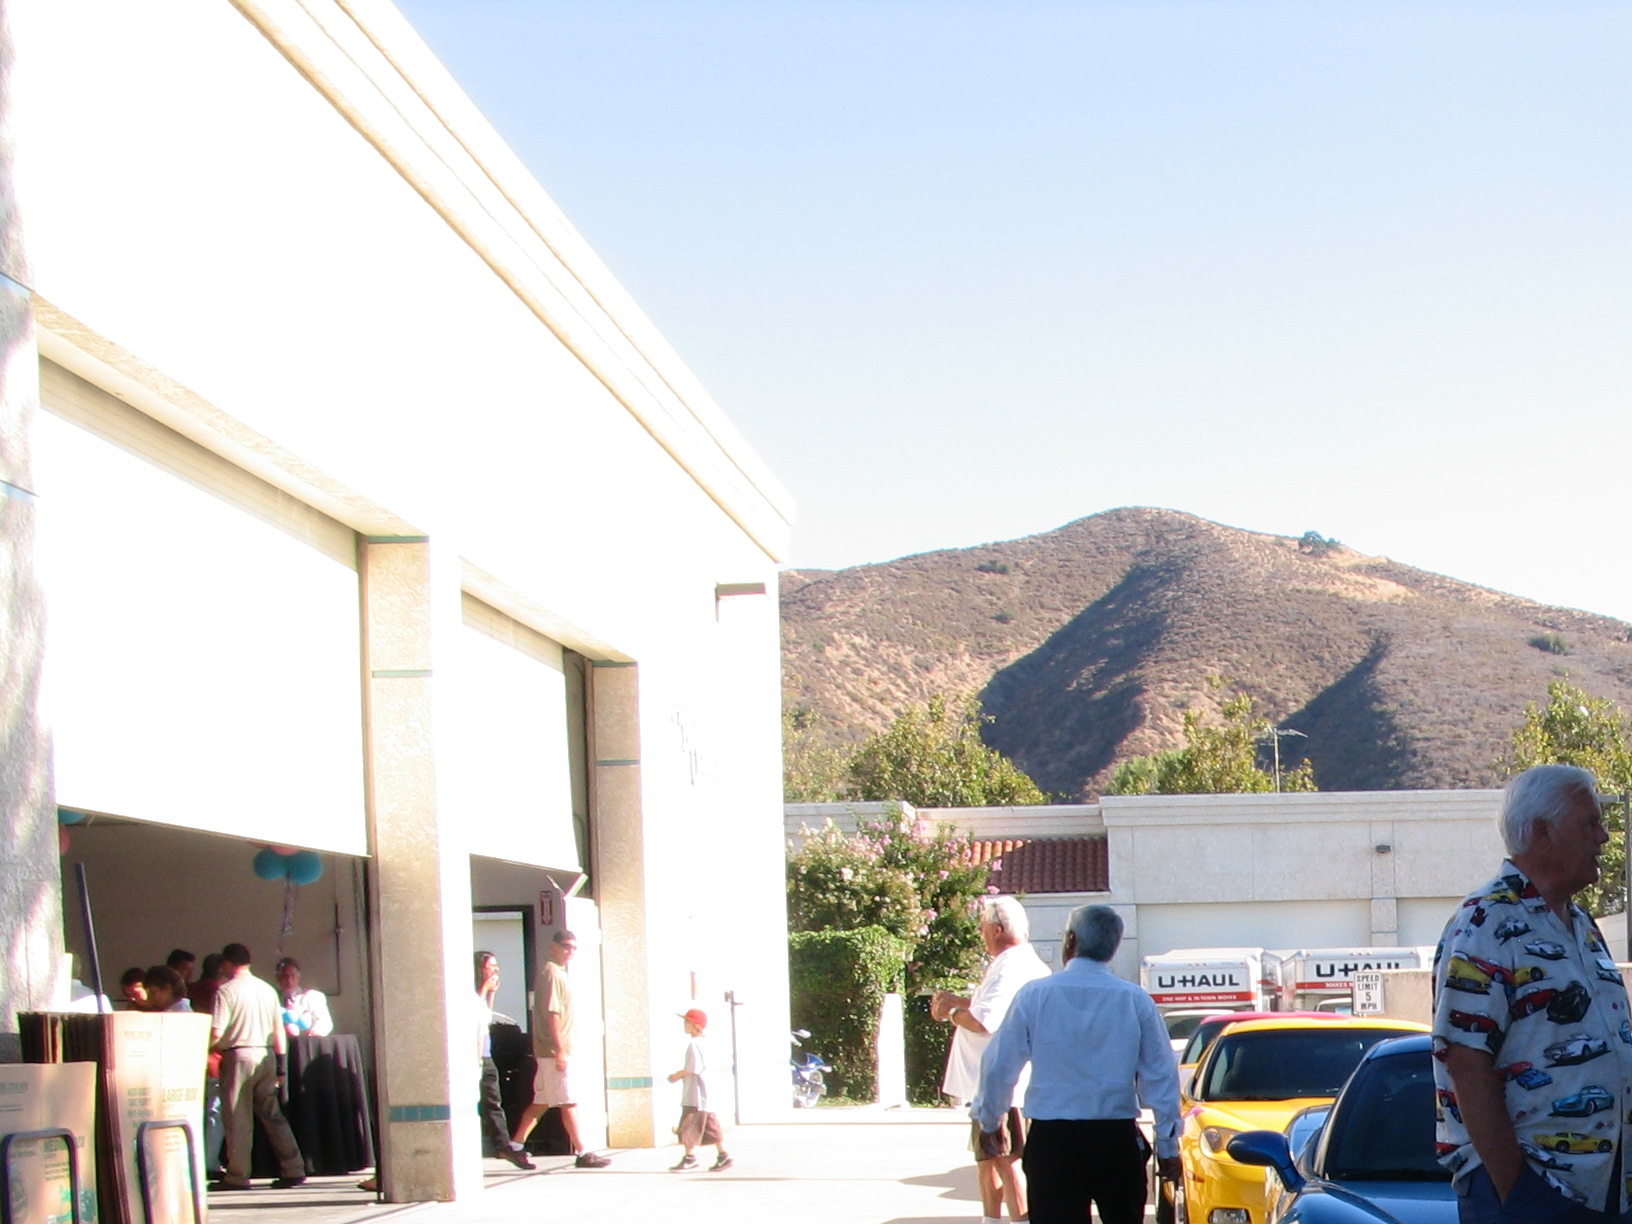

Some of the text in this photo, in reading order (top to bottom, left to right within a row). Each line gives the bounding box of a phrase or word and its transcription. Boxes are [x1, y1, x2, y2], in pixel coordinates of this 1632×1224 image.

[1157, 973, 1240, 988] U-HAUL
[1356, 974, 1379, 982] SPEED
[1357, 983, 1379, 991] LIMIT
[1365, 991, 1372, 1001] 5
